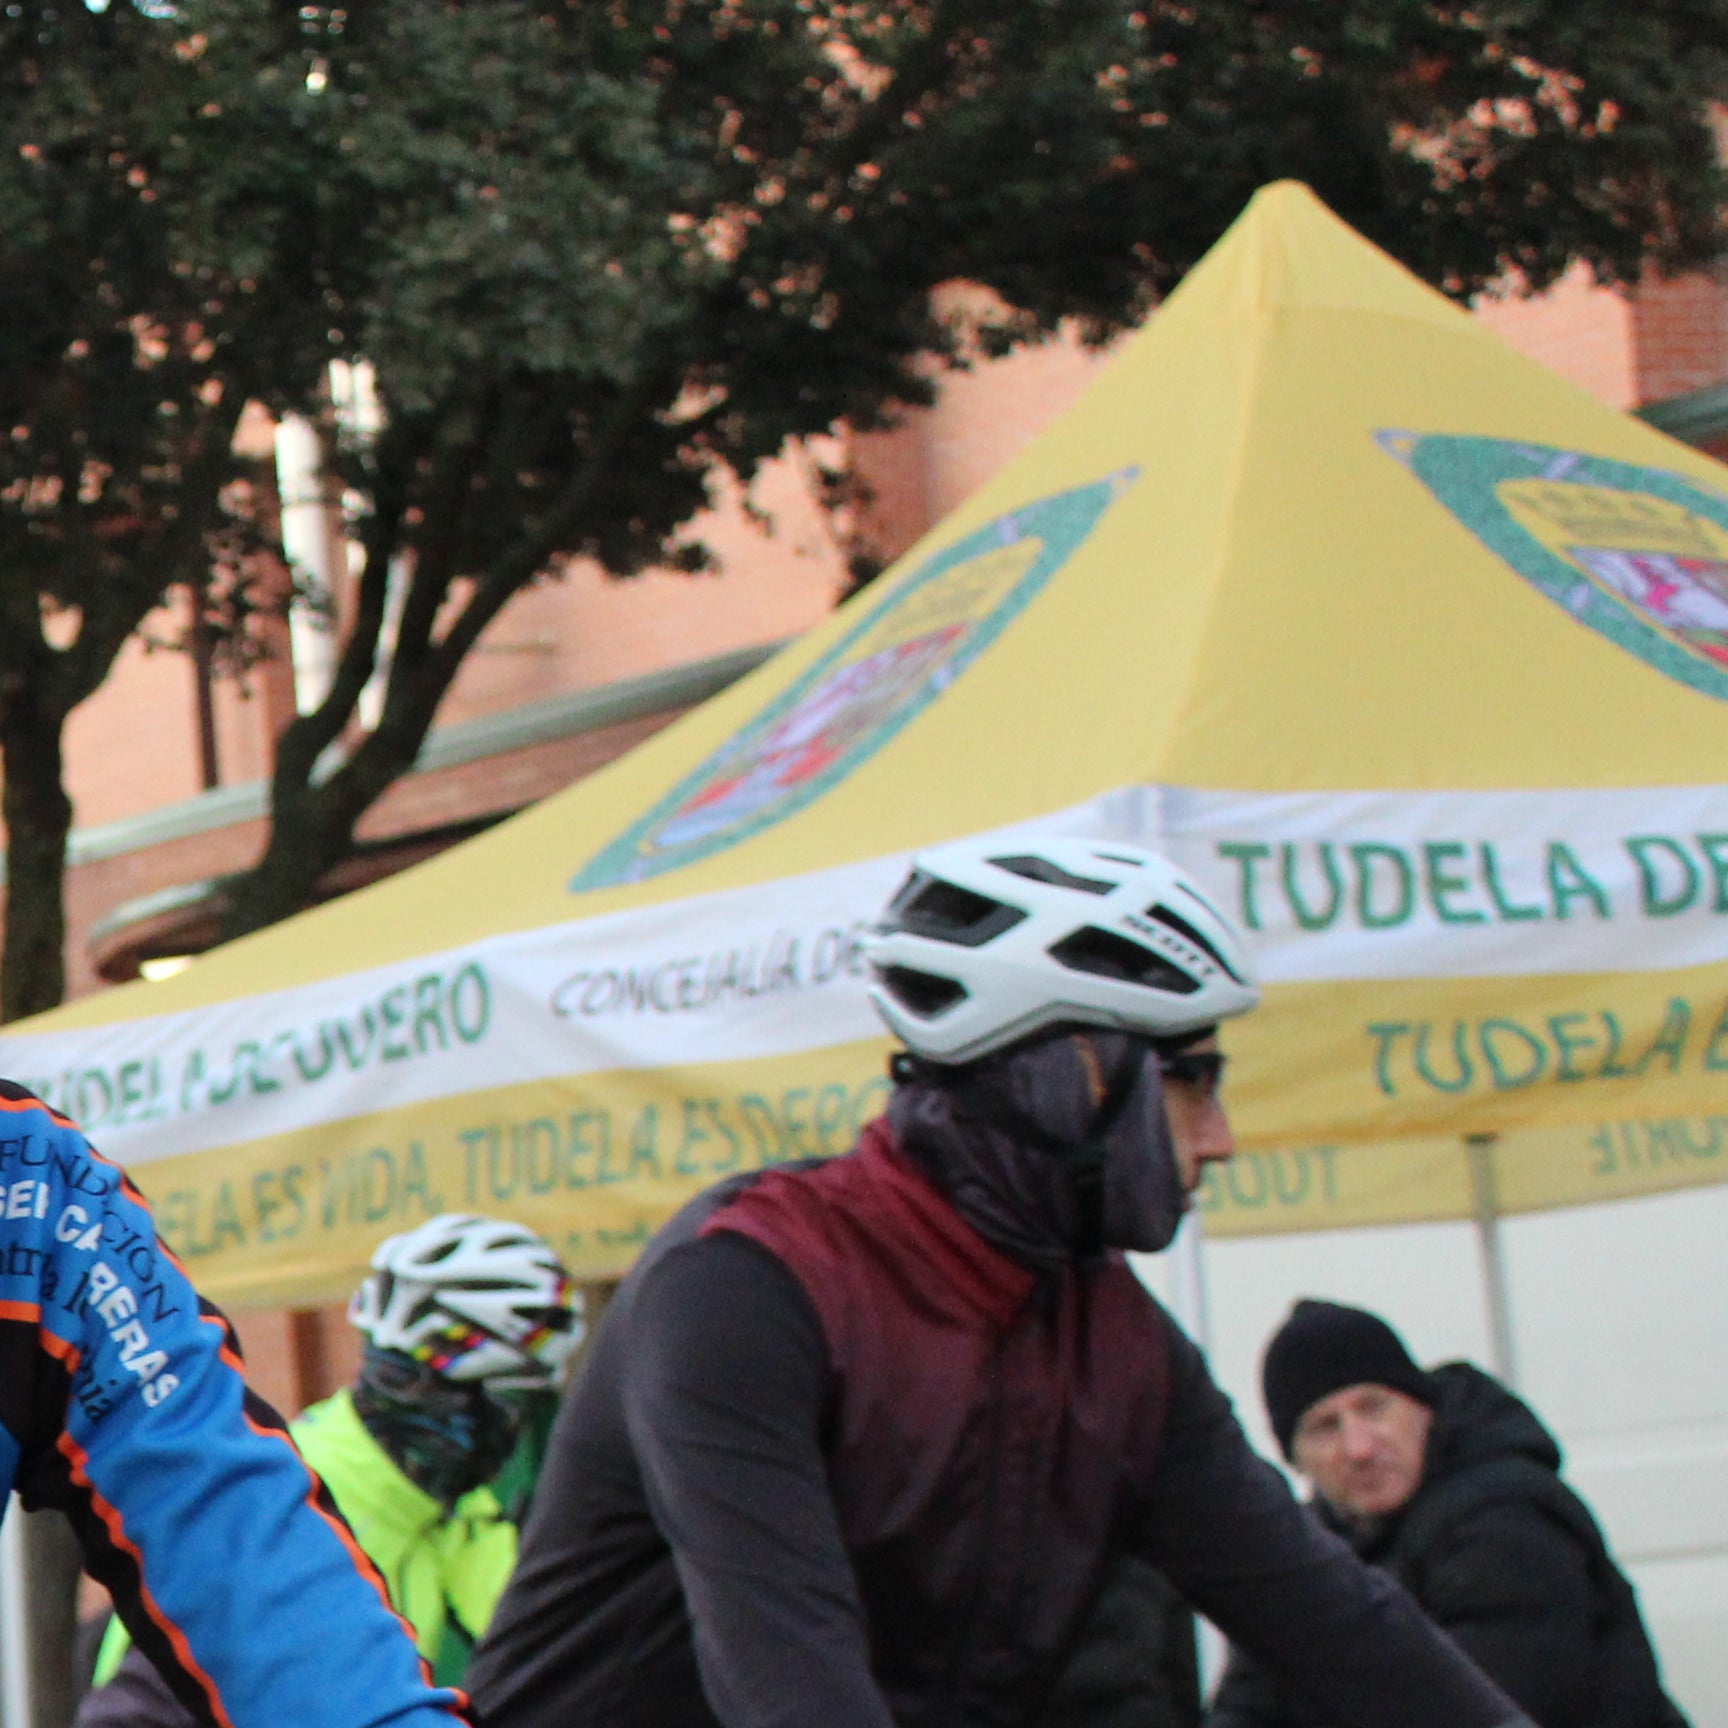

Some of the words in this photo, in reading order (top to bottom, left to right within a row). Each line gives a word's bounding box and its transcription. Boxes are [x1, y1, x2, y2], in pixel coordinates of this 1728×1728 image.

[1218, 838, 1613, 930] TUDELA
[1366, 995, 1692, 1096] TUDELA
[457, 1105, 661, 1204] TUDELA
